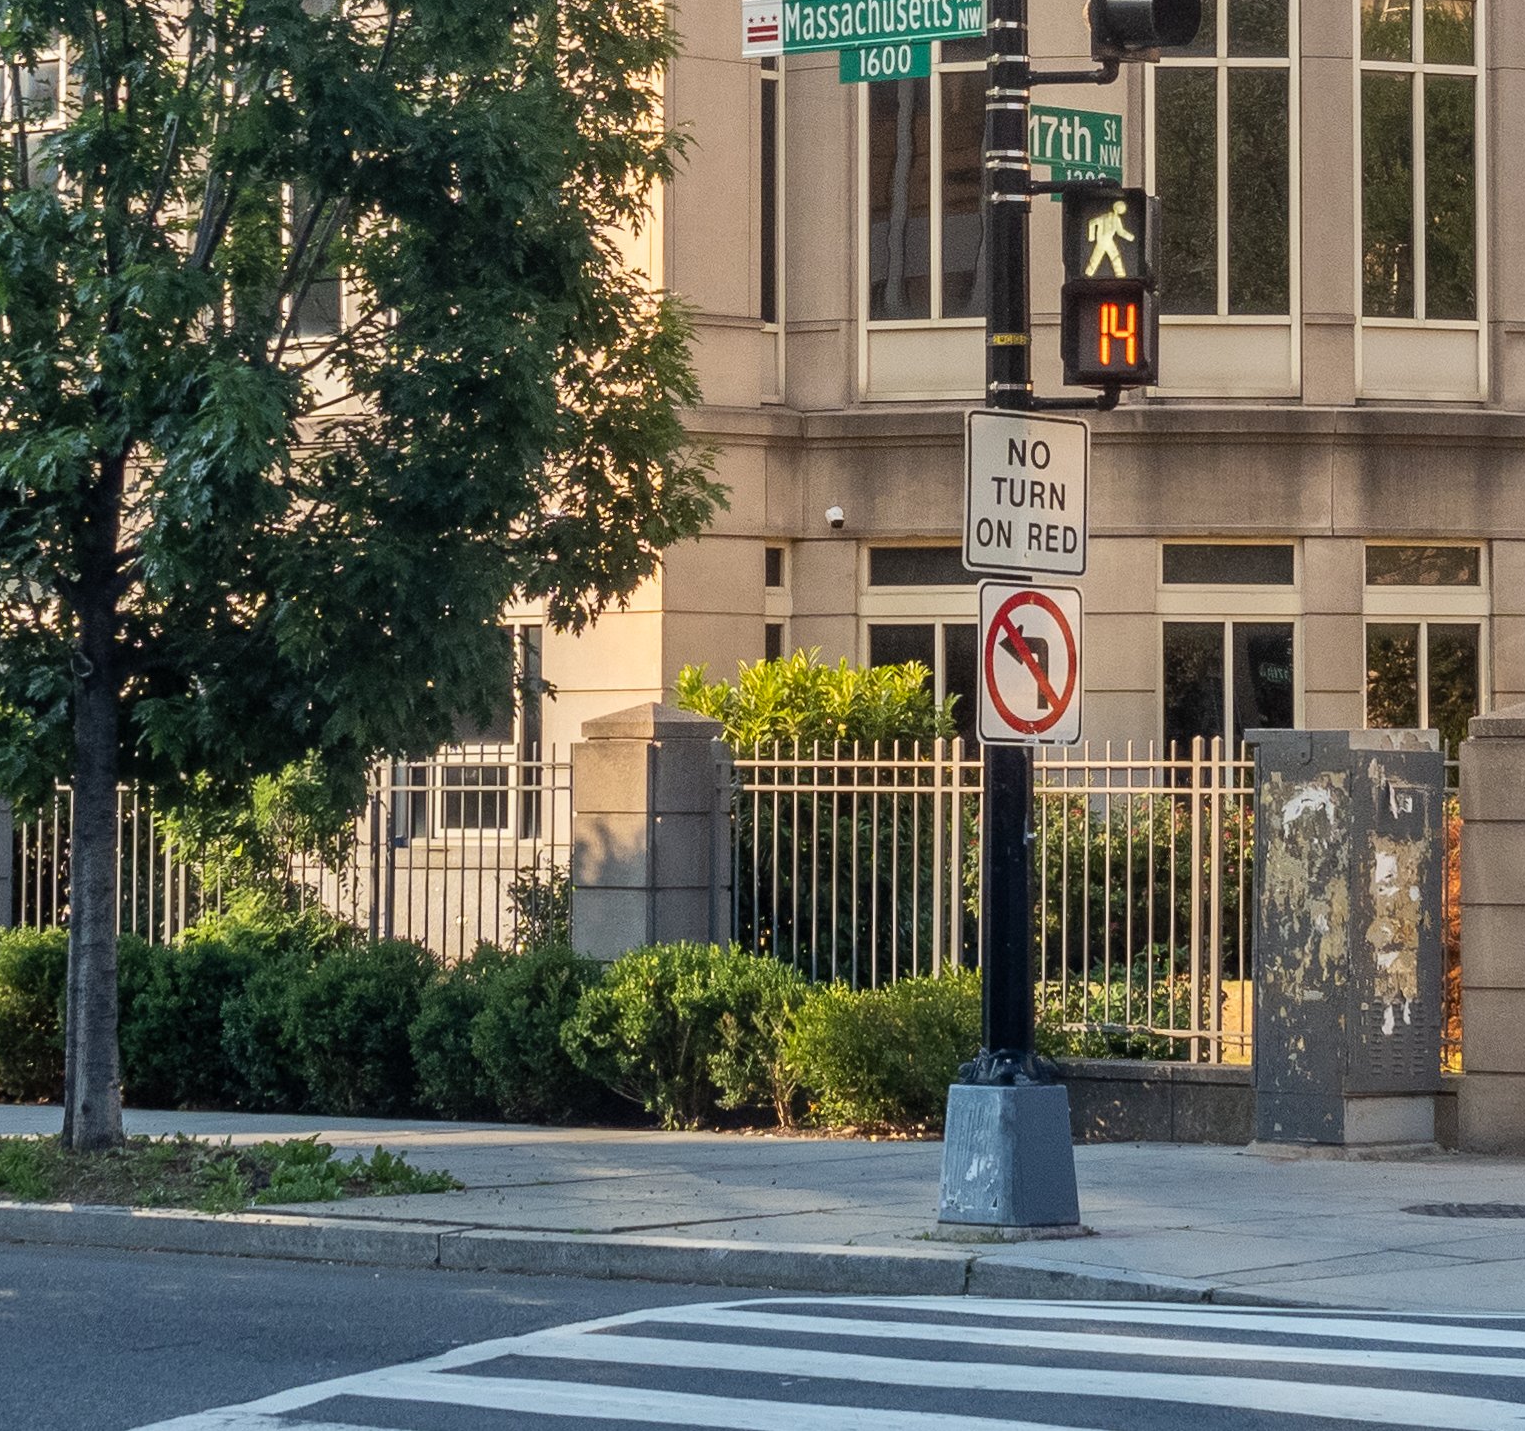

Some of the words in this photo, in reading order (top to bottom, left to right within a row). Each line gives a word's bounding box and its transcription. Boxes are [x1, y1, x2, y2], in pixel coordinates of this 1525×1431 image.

[958, 7, 981, 30] NW
[859, 45, 911, 76] 1600
[1029, 115, 1092, 162] 17th
[1104, 119, 1116, 142] St
[1099, 144, 1121, 167] NW
[1099, 303, 1137, 366] 14
[1008, 438, 1051, 470] NO
[991, 476, 1066, 511] TURN
[977, 518, 1012, 549] ON
[1028, 522, 1078, 554] RED
